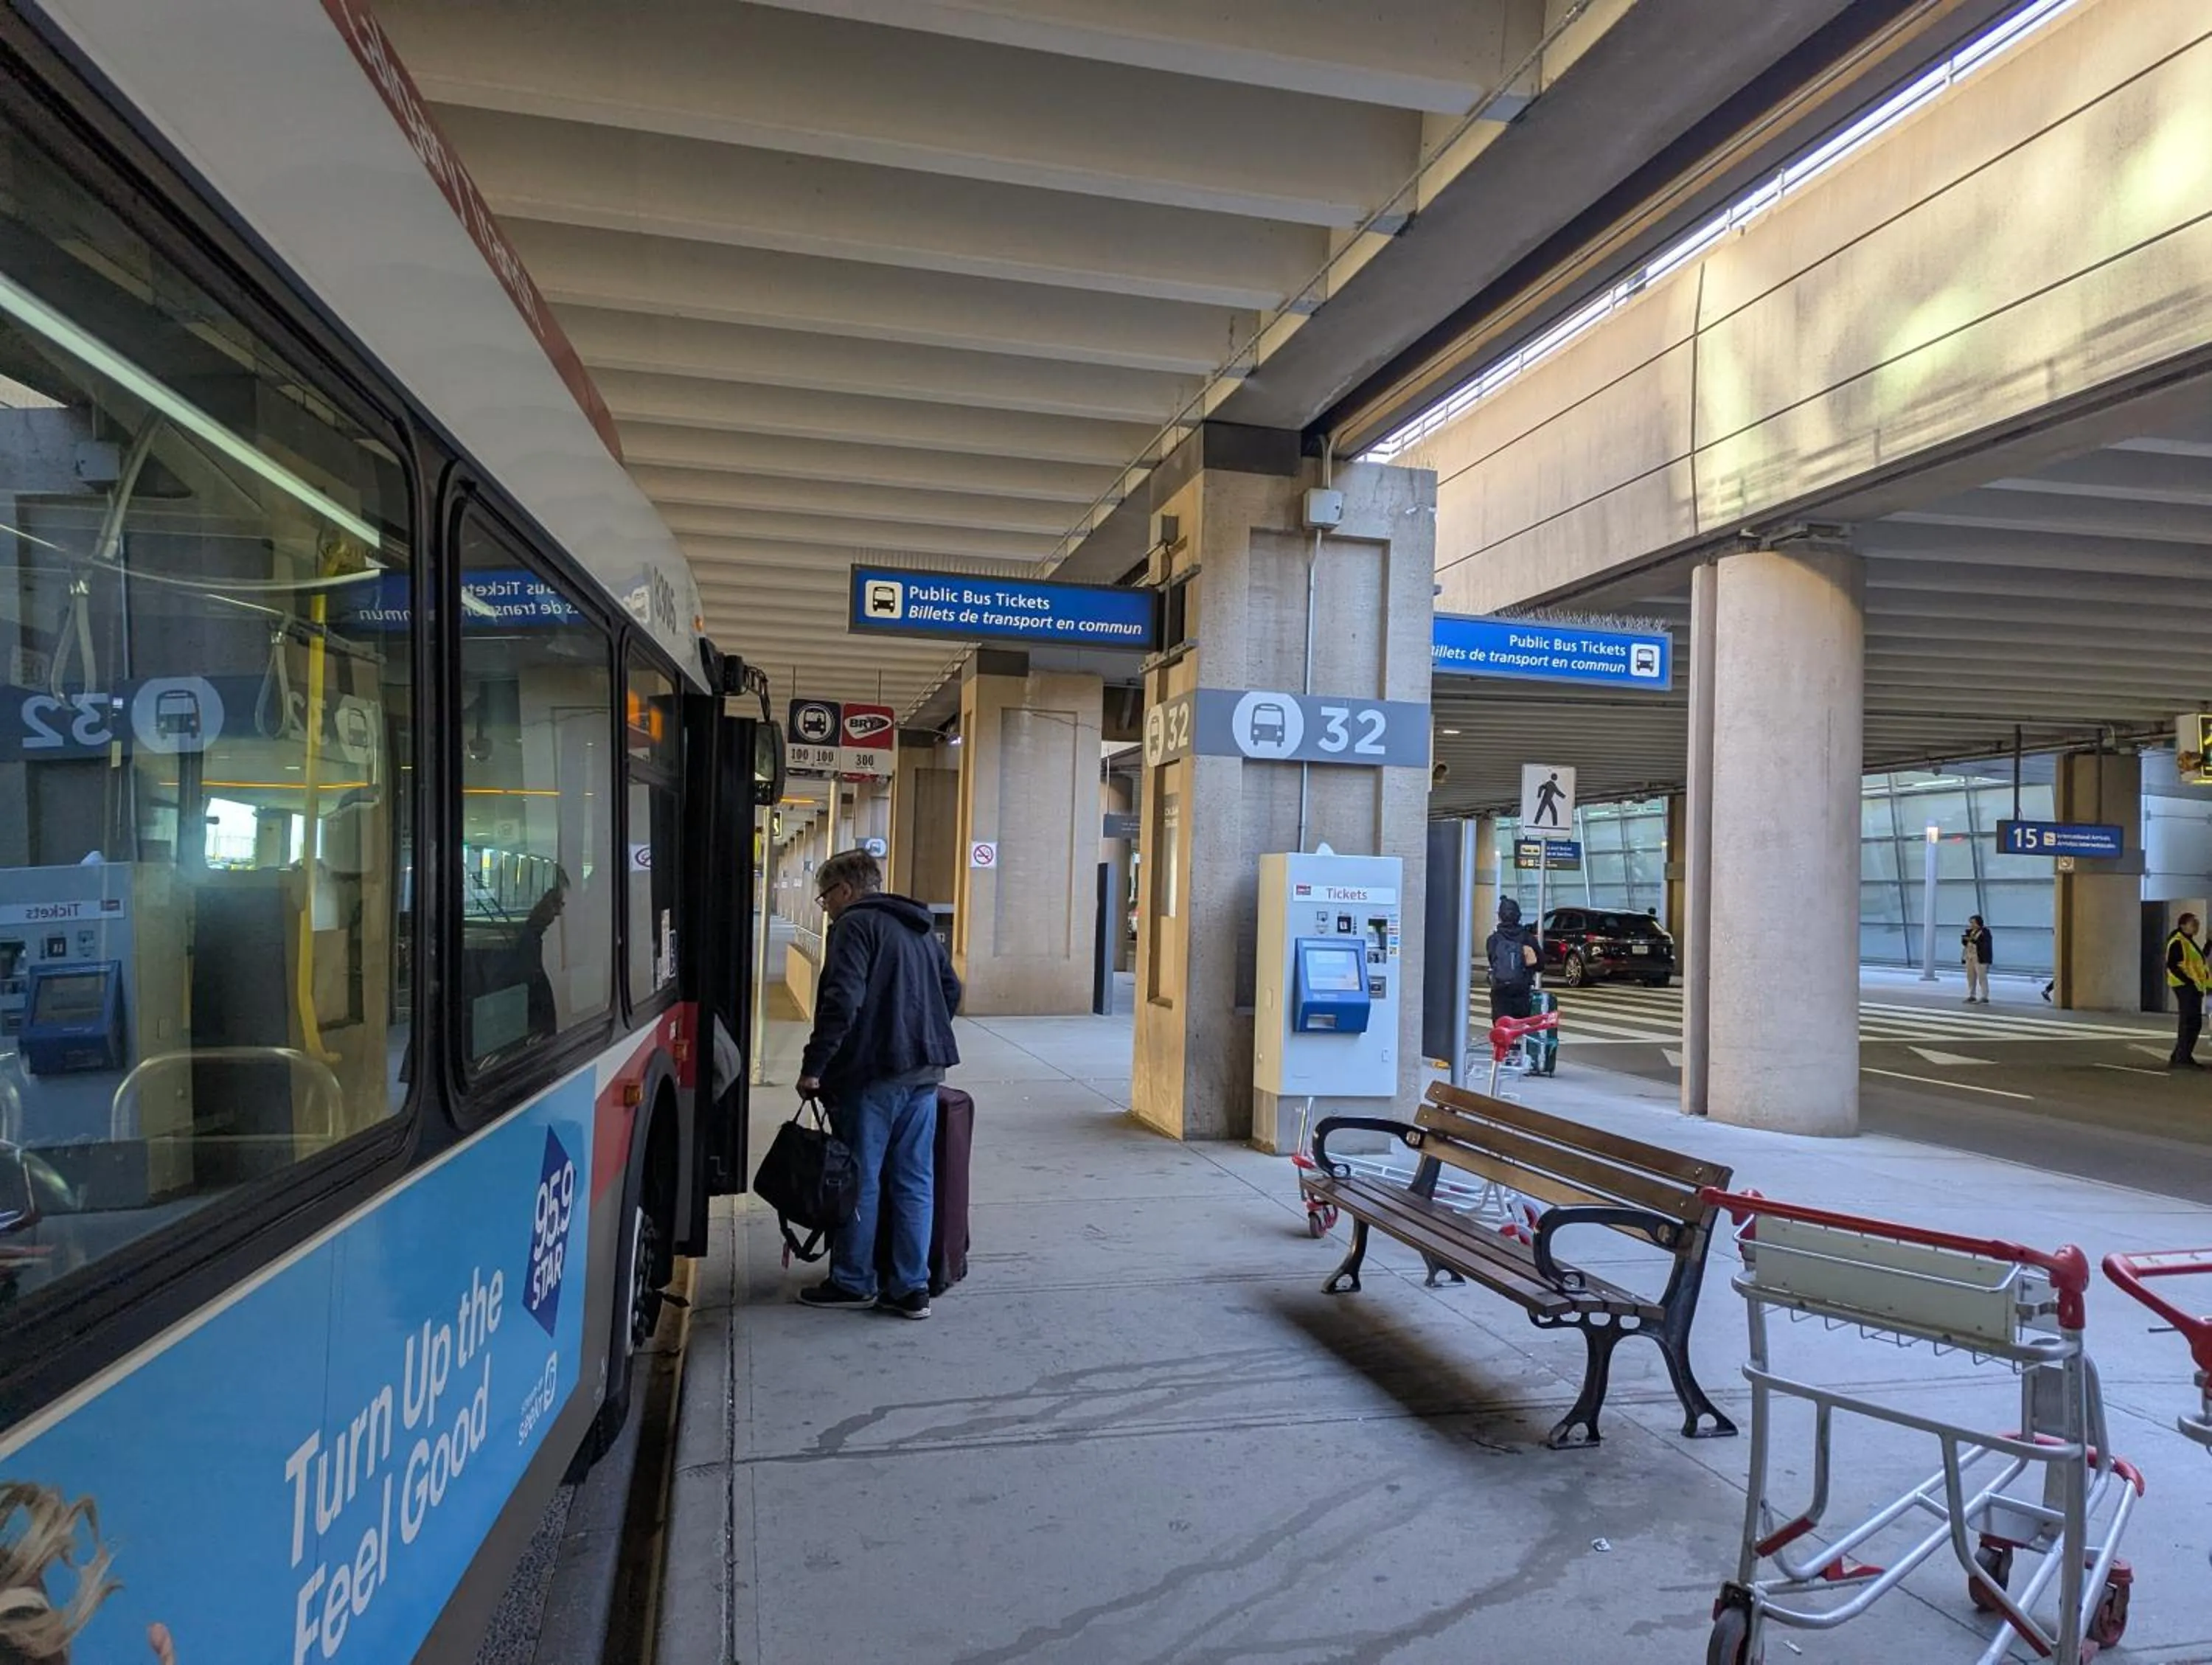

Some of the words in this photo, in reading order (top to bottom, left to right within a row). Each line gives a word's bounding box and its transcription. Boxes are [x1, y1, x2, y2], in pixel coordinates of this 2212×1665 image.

[909, 585, 958, 603] Public
[964, 590, 991, 605] Bus
[996, 592, 1050, 610] Tickets
[908, 605, 955, 622] Billets
[959, 608, 978, 624] de
[983, 611, 1053, 632] transport
[1057, 619, 1074, 630] en
[1078, 619, 1142, 636] commun
[1509, 634, 1549, 650] Public
[1554, 637, 1576, 652] Bus
[1580, 640, 1626, 656] Tickets
[1470, 648, 1486, 661] de
[1489, 651, 1548, 667] transport
[1552, 656, 1568, 669] en
[1571, 659, 1626, 673] commun
[1167, 703, 1189, 751] 32
[1317, 706, 1387, 755] 32
[790, 748, 809, 760] 100
[816, 750, 834, 762] 100
[856, 754, 874, 766] 300
[2013, 828, 2037, 849] 15
[1326, 887, 1368, 900] Tickets
[532, 1242, 563, 1310] STAR
[285, 1383, 392, 1569] Turn
[403, 1318, 451, 1429] Up
[456, 1265, 504, 1370] the
[293, 1473, 392, 1665] Feel
[400, 1352, 491, 1545] Good
